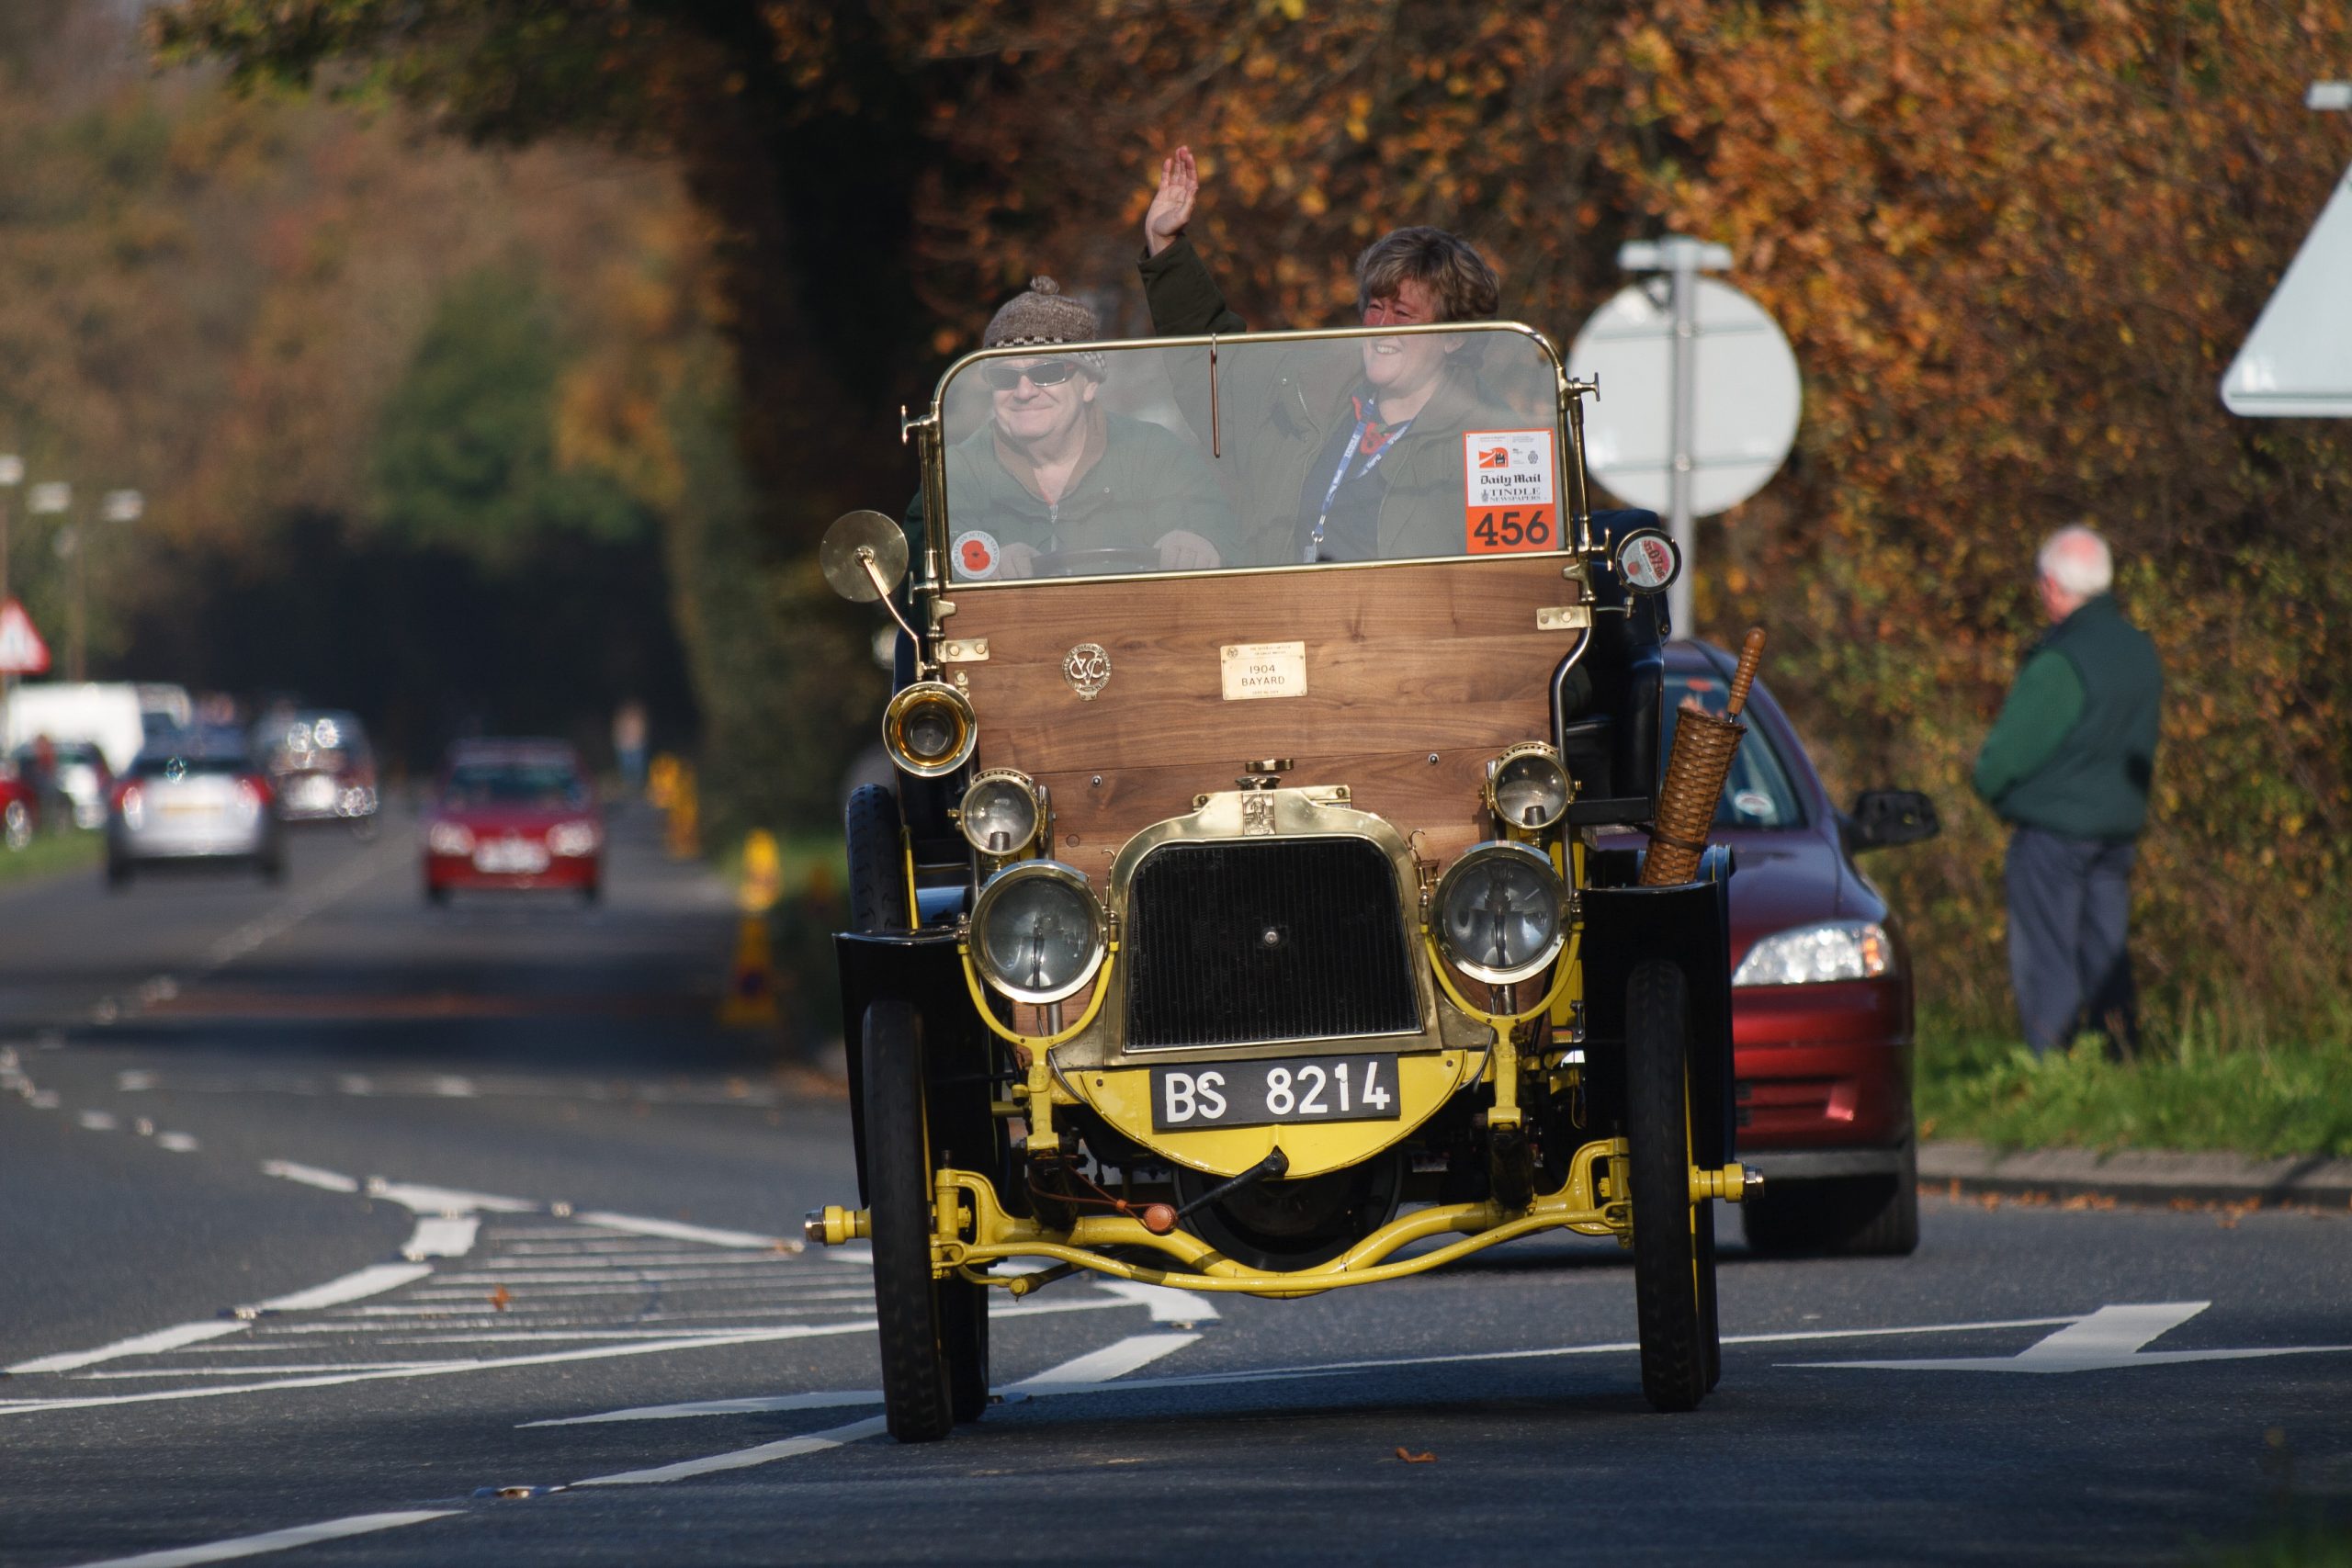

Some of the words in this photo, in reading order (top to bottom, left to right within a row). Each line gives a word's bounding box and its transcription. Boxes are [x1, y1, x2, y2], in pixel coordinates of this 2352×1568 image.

[1481, 475, 1511, 487] Daily
[1514, 474, 1541, 483] Mail
[1490, 487, 1541, 497] TINDLE
[1474, 511, 1550, 546] 456
[1250, 664, 1275, 674] 1904
[1241, 676, 1285, 687] BAYARD
[1165, 1071, 1227, 1122] BS
[1266, 1062, 1391, 1115] 8214
